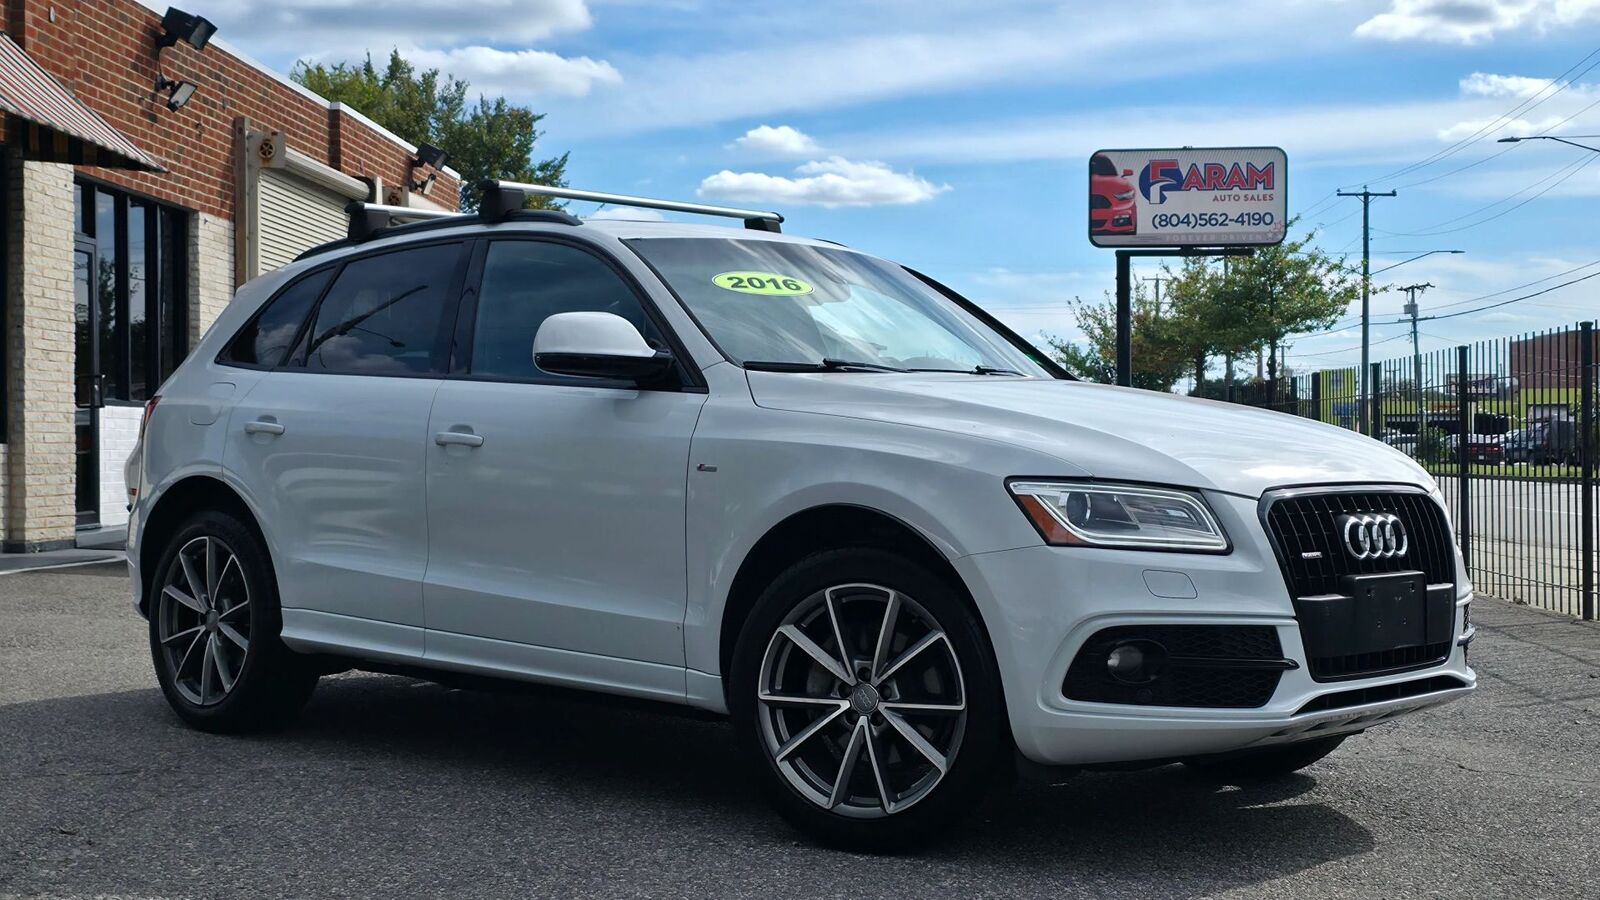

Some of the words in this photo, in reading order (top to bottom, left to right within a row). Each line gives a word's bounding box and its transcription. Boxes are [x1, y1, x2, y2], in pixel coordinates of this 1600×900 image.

[1212, 194, 1240, 202] AUTO
[1243, 193, 1274, 201] SALES
[1151, 211, 1275, 229] (804)562-4190
[1165, 234, 1216, 242] FOREVER
[1222, 233, 1263, 241] DRIVEN
[726, 276, 802, 291] 2016
